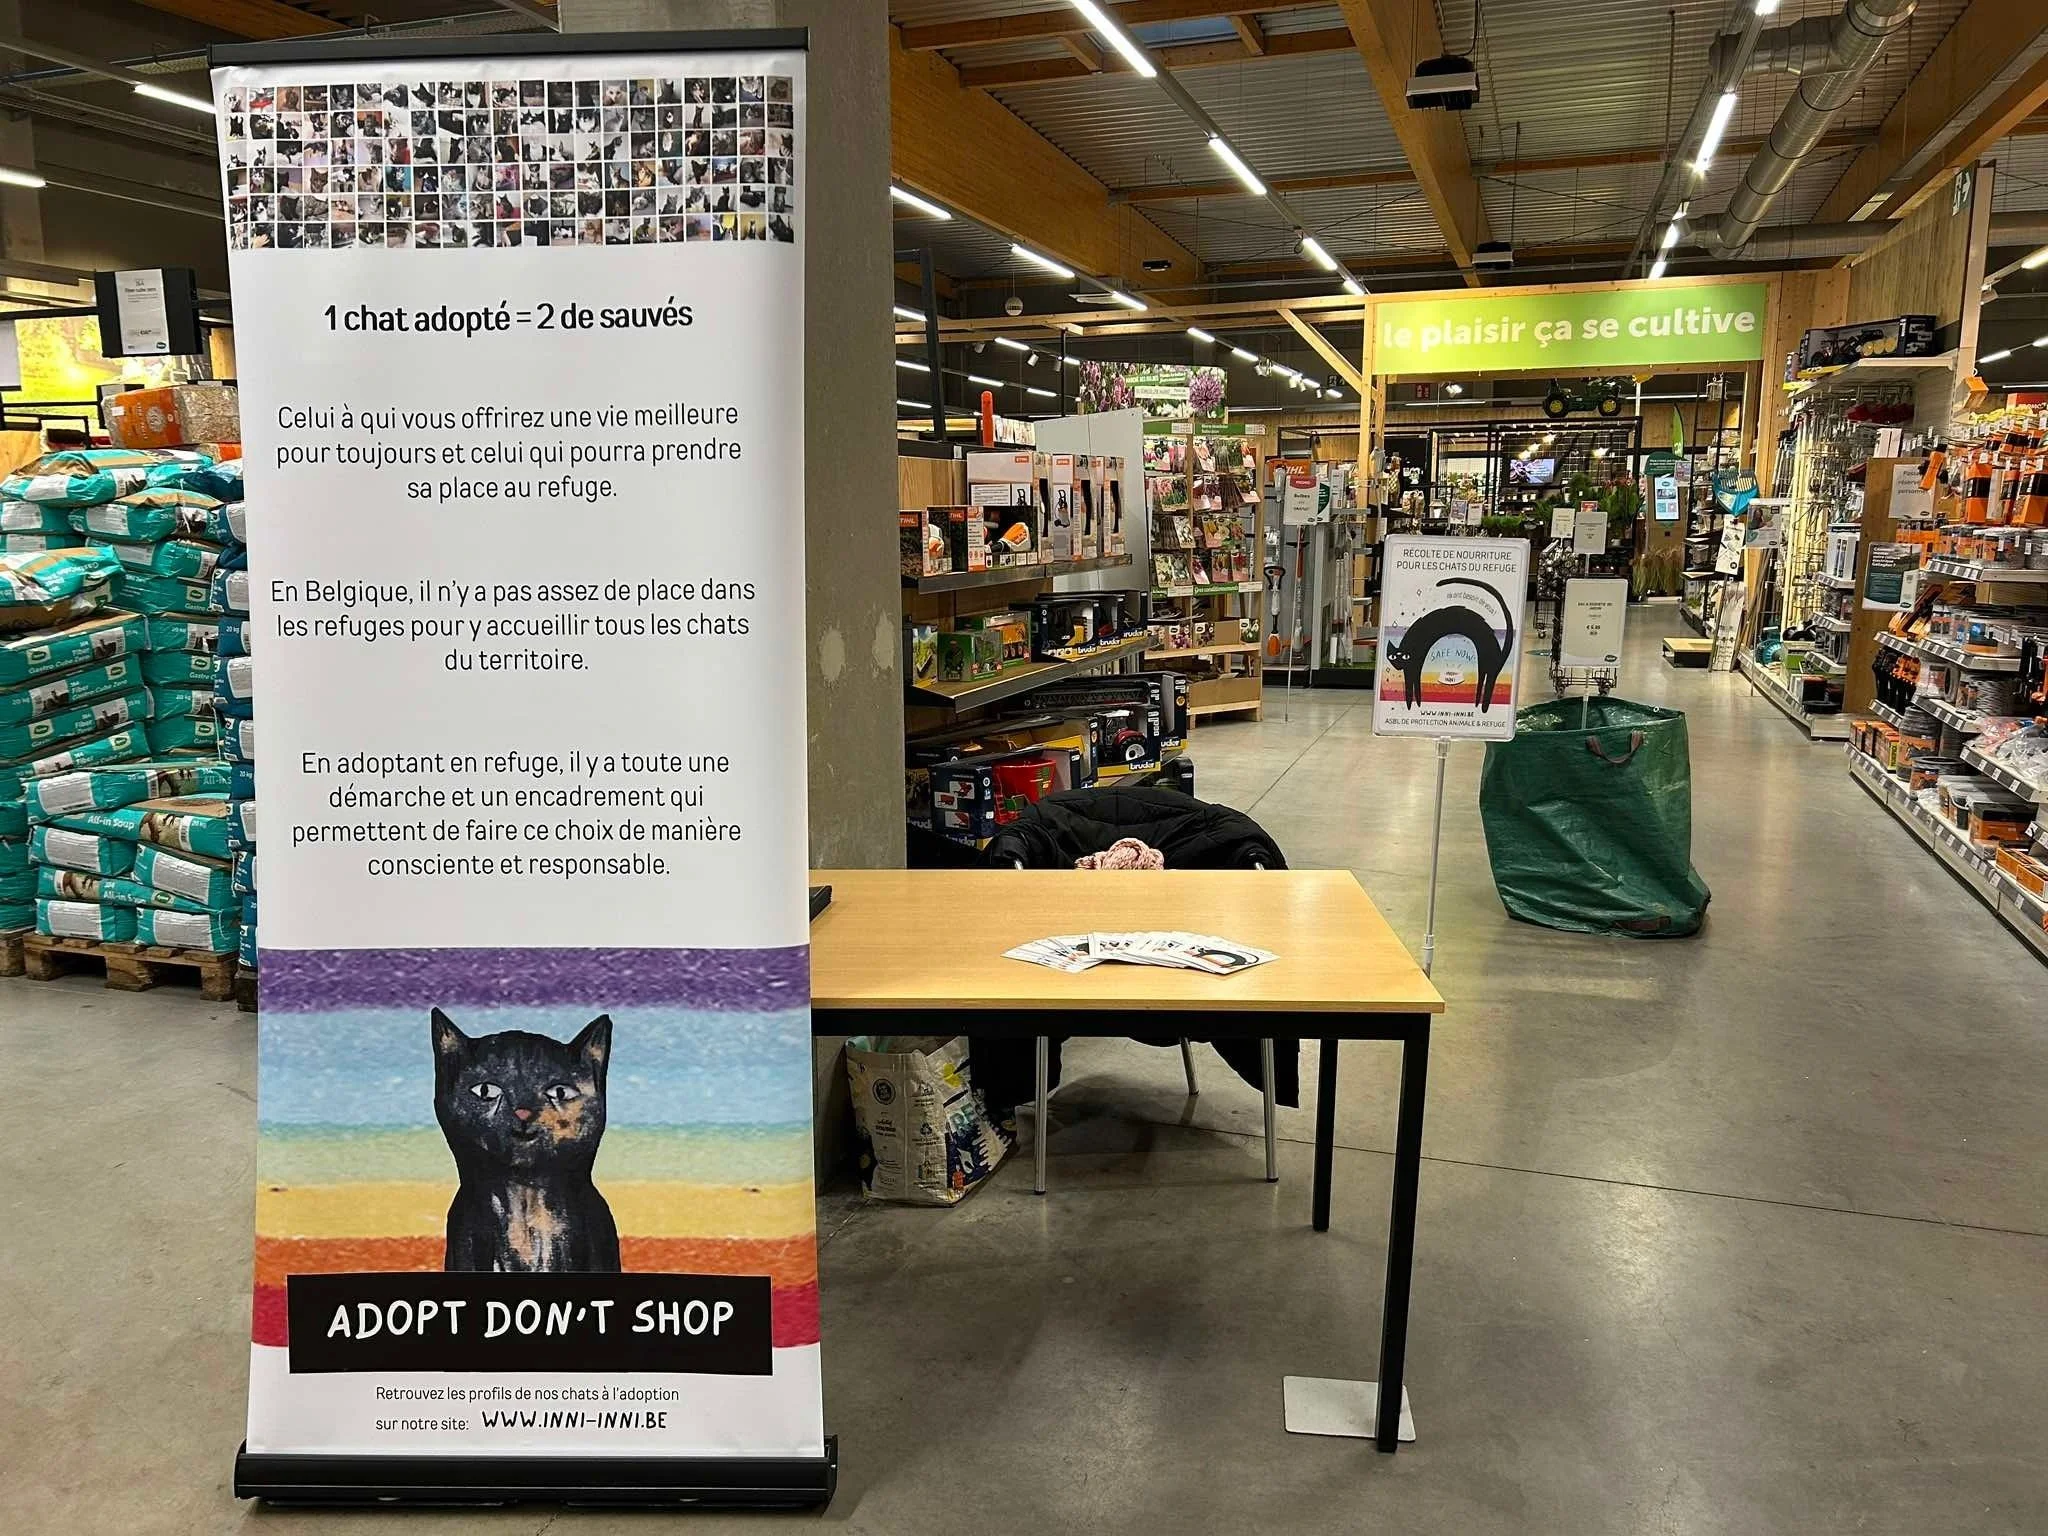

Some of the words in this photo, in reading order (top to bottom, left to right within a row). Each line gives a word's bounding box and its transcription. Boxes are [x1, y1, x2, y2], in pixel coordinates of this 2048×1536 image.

[324, 304, 336, 331] 1
[344, 304, 410, 332] chat
[414, 299, 511, 339] adopté
[516, 311, 532, 323] =
[536, 302, 555, 330] 2
[560, 302, 594, 330] de
[599, 295, 694, 329] sauvés
[1383, 322, 1411, 349] le
[1420, 316, 1526, 352] plaisir
[1534, 319, 1572, 348] ça
[1582, 314, 1619, 339] se
[1628, 306, 1755, 338] cultive
[278, 406, 335, 429] Celui
[341, 402, 354, 429] à
[360, 407, 396, 435] qui
[401, 412, 456, 430] vous
[461, 406, 545, 429] offrirez
[550, 410, 592, 428] une
[596, 404, 628, 428] vie
[634, 402, 738, 427] meilleure
[277, 446, 331, 470] pour
[335, 441, 436, 470] toujours
[442, 443, 466, 464] et
[471, 440, 523, 464] celui
[529, 440, 563, 469] qui
[570, 444, 645, 469] pourra
[652, 436, 742, 467] prendre
[407, 481, 432, 499] sa
[439, 475, 499, 505] place
[504, 481, 531, 498] au
[538, 474, 617, 504] refuge.
[899, 517, 917, 525] TIHL
[1397, 561, 1420, 570] POUR
[1422, 562, 1438, 571] LES
[1439, 562, 1467, 572] CHATS
[1469, 563, 1480, 572] DU
[1483, 563, 1517, 573] REFUGE
[1443, 550, 1454, 559] DE
[1456, 550, 1512, 560] NOURRITURE
[271, 580, 298, 602] En
[305, 579, 414, 608] Belgique,
[419, 579, 431, 602] il
[438, 579, 470, 608] n'y
[474, 585, 487, 602] a
[493, 584, 532, 608] pas
[537, 584, 599, 602] assez
[604, 578, 631, 601] de
[637, 578, 695, 607] place
[701, 577, 756, 601] dans
[277, 614, 308, 637] les
[314, 614, 405, 643] refuges
[411, 619, 465, 642] pour
[469, 619, 482, 642] y
[486, 613, 590, 637] accueillir
[594, 615, 645, 636] tous
[651, 612, 682, 636] les
[687, 612, 750, 635] chats
[1078, 646, 1097, 654] bruder
[1099, 638, 1121, 646] bruder
[444, 648, 473, 671] du
[478, 648, 589, 671] territoire.
[1410, 718, 1448, 726] PROTECTION
[1449, 719, 1475, 727] ANIMALE
[1482, 720, 1506, 728] REFUGE
[1160, 738, 1181, 748] uder
[302, 752, 331, 774] En
[337, 751, 445, 779] adoptant
[450, 756, 477, 773] en
[484, 750, 564, 779] refuge,
[570, 750, 580, 773] il
[585, 756, 599, 779] y
[603, 755, 615, 773] a
[620, 752, 682, 773] toute
[688, 755, 729, 773] une
[1130, 761, 1155, 770] bruder
[329, 782, 446, 808] démarche
[451, 787, 476, 807] et
[481, 790, 509, 807] un
[515, 784, 666, 807] encadrement
[670, 785, 703, 813] qui
[88, 815, 112, 826] All-in
[112, 818, 135, 832] Soup
[293, 821, 428, 848] permettent
[432, 819, 460, 841] de
[465, 818, 518, 841] faire
[523, 824, 549, 841] ce
[555, 818, 614, 841] choix
[619, 818, 645, 841] de
[652, 815, 741, 841] manière
[368, 853, 494, 876] consciente
[500, 854, 524, 875] et
[529, 852, 670, 880] responsable.
[326, 1299, 467, 1340] ADOPT
[483, 1299, 615, 1339] DON'T
[631, 1299, 734, 1337] SHOP
[376, 1386, 445, 1400] Retrouvez
[447, 1386, 466, 1401] les
[469, 1386, 512, 1404] profils
[514, 1386, 532, 1400] de
[534, 1389, 559, 1401] nos
[561, 1386, 599, 1401] chats
[601, 1384, 609, 1401] à
[613, 1386, 679, 1404] l'adoption
[375, 1419, 399, 1431] sur
[401, 1418, 438, 1431] notre
[440, 1416, 470, 1431] site:
[481, 1410, 668, 1430] WWW.INNI-INNI.BE
